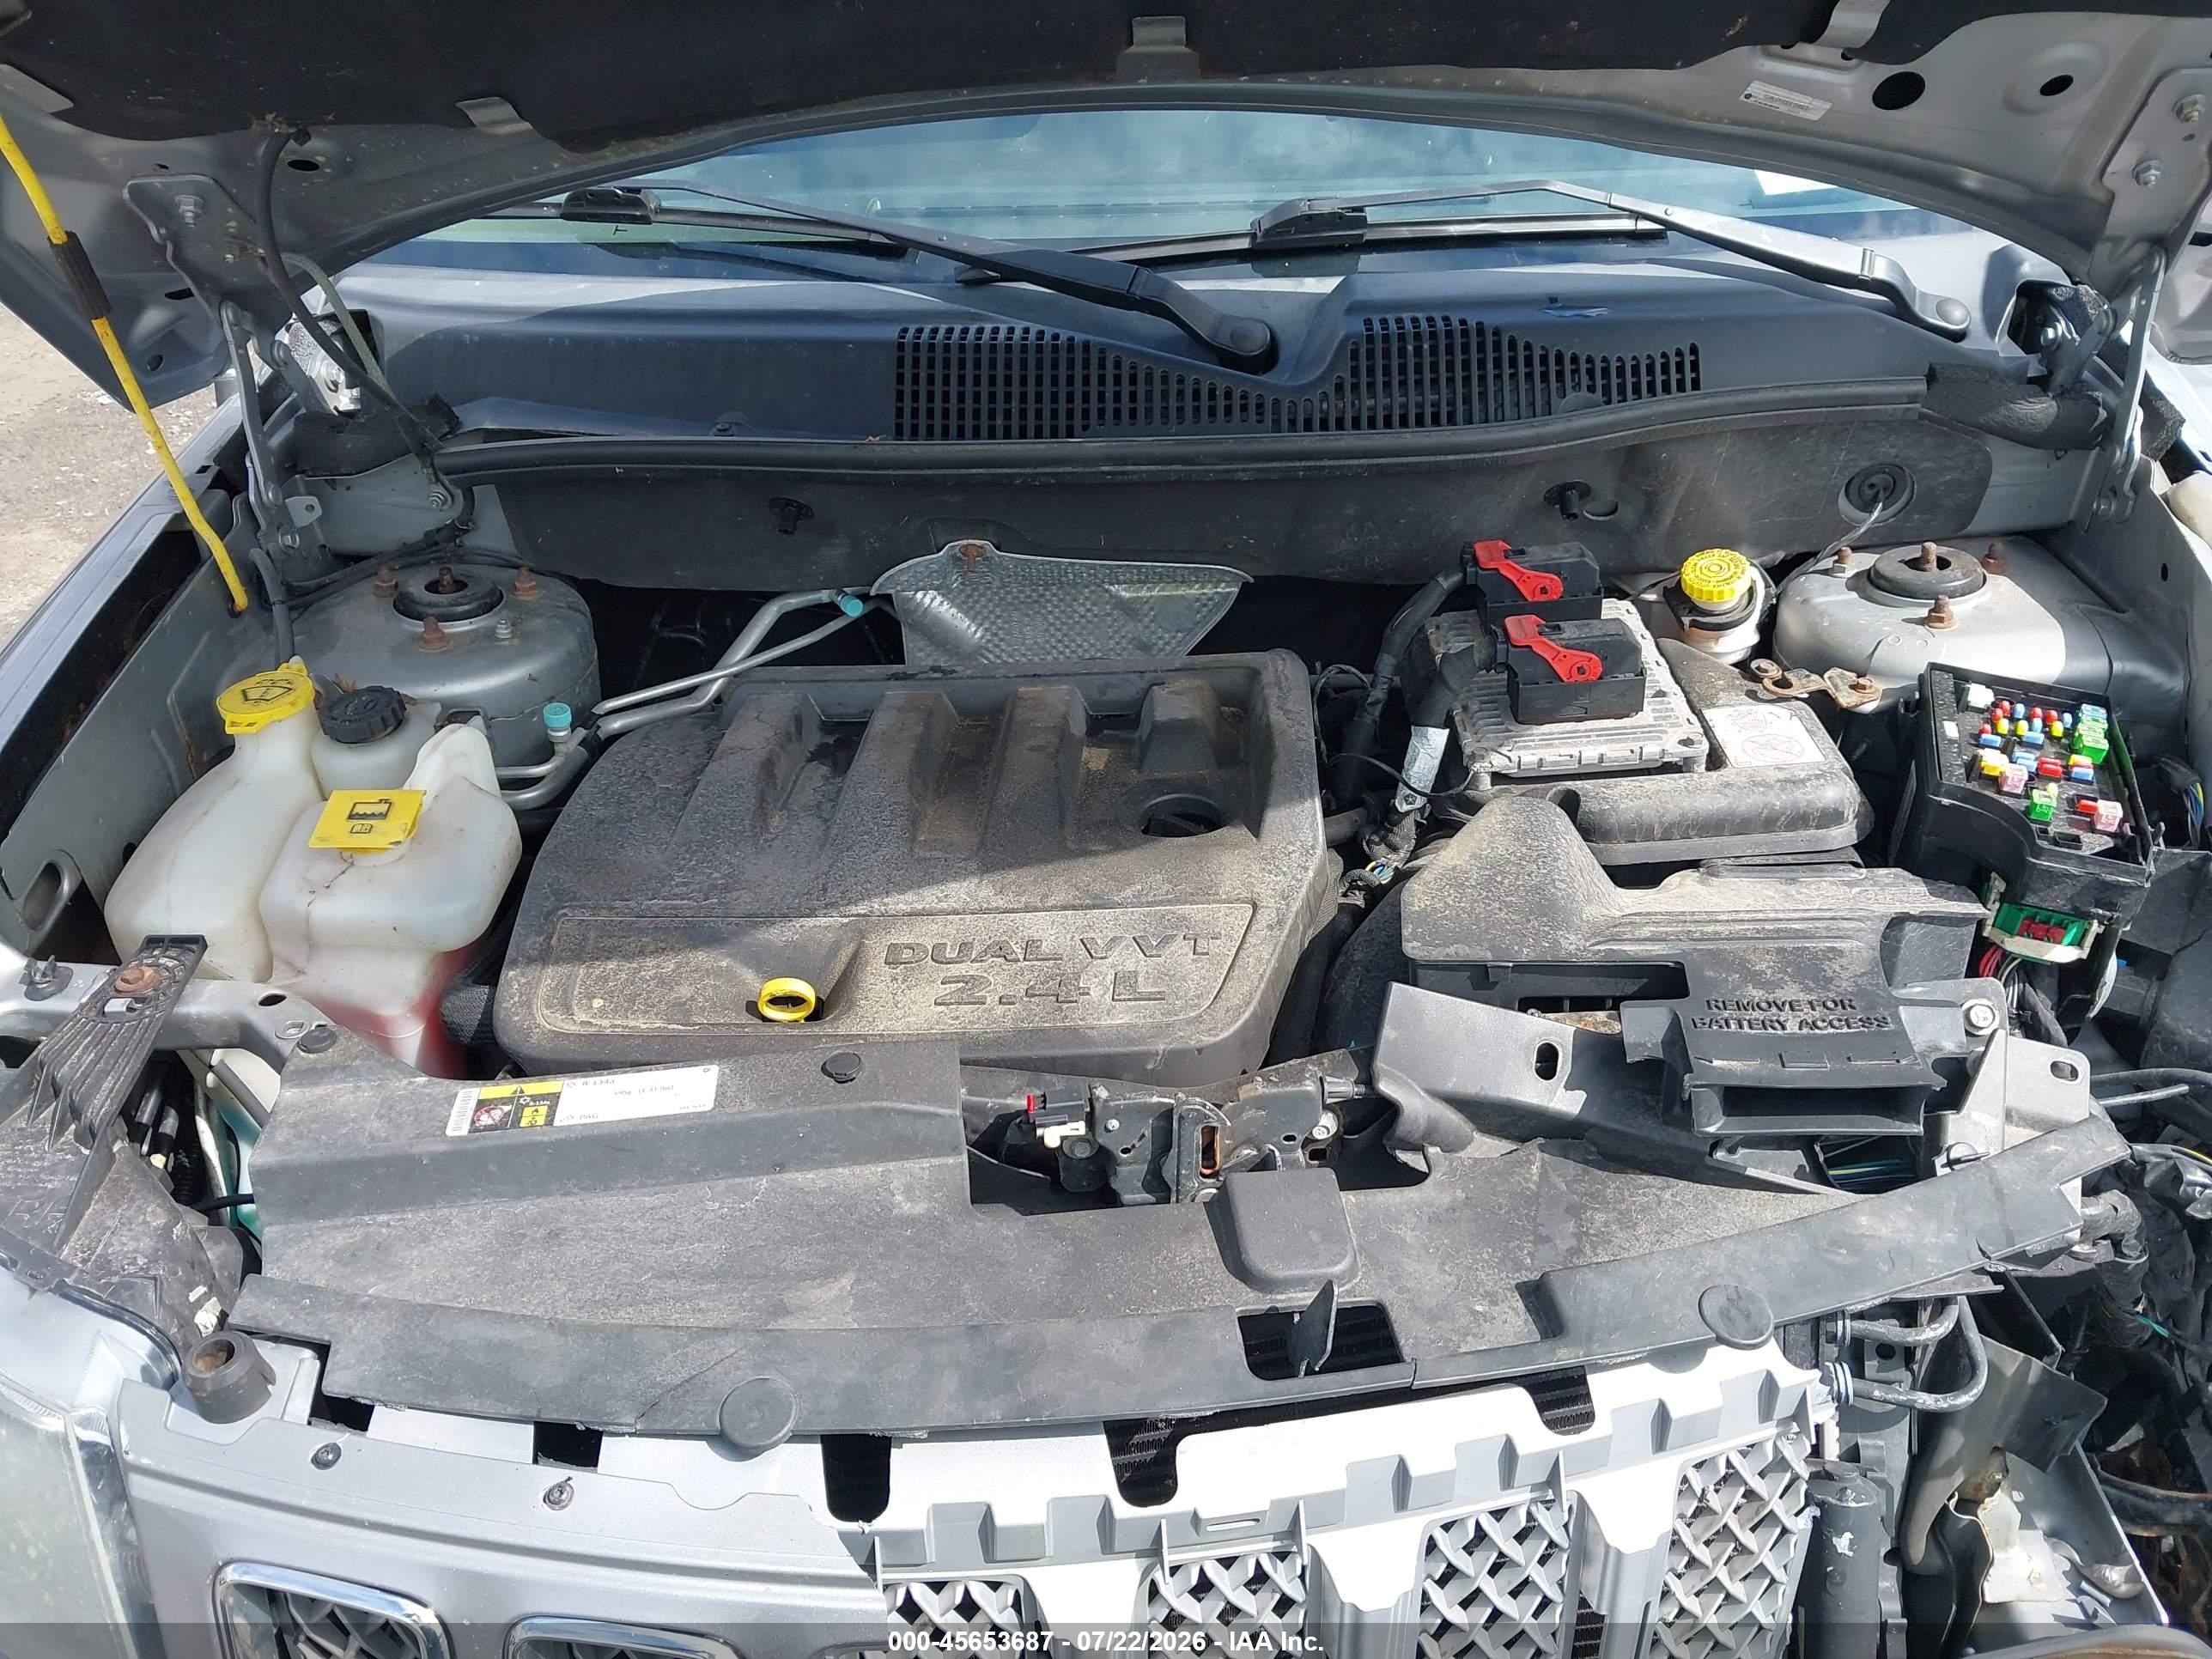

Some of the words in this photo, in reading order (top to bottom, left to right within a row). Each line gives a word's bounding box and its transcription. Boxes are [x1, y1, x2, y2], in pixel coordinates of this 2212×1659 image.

[884, 939, 1063, 966] DUAL
[1080, 933, 1222, 960] VVT
[934, 970, 1166, 1006] 2.4L
[1705, 998, 1807, 1012] REMOVE
[1808, 998, 1857, 1012] FOR
[1691, 1017, 1789, 1032] BATTERY
[1798, 1015, 1893, 1031] ACCESS
